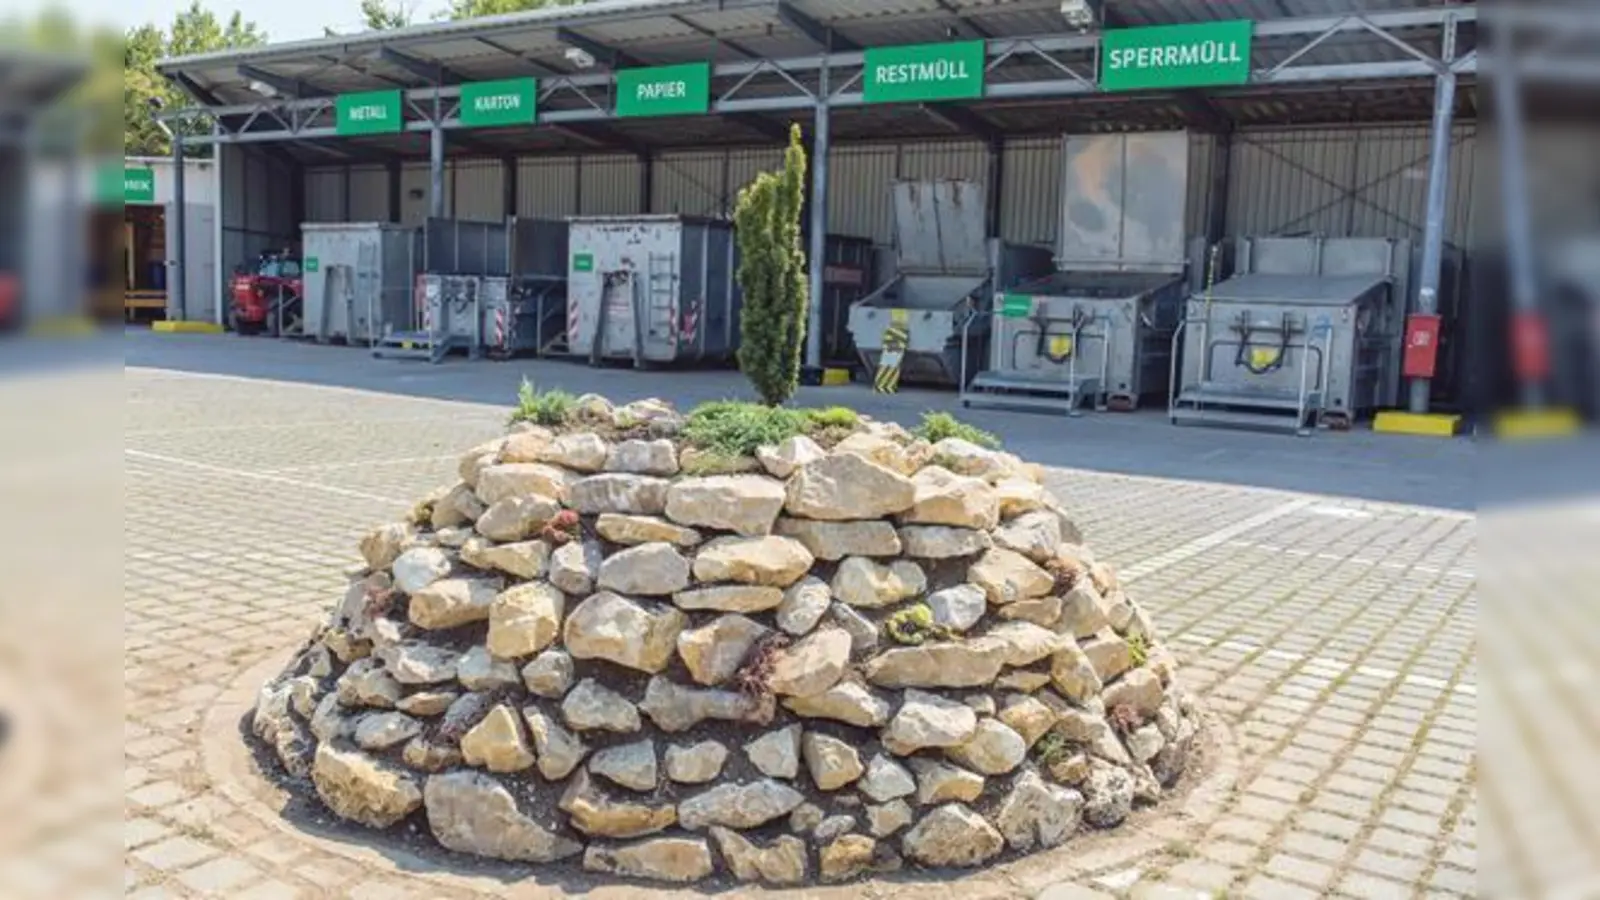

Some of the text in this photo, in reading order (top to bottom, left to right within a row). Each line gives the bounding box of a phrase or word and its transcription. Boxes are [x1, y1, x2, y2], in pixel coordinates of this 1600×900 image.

[1109, 40, 1241, 69] SPERRMÜLL
[875, 60, 969, 84] RESTMÜLL
[636, 80, 686, 100] PAPIER
[349, 104, 387, 121] METALL
[474, 94, 521, 111] KARTON
